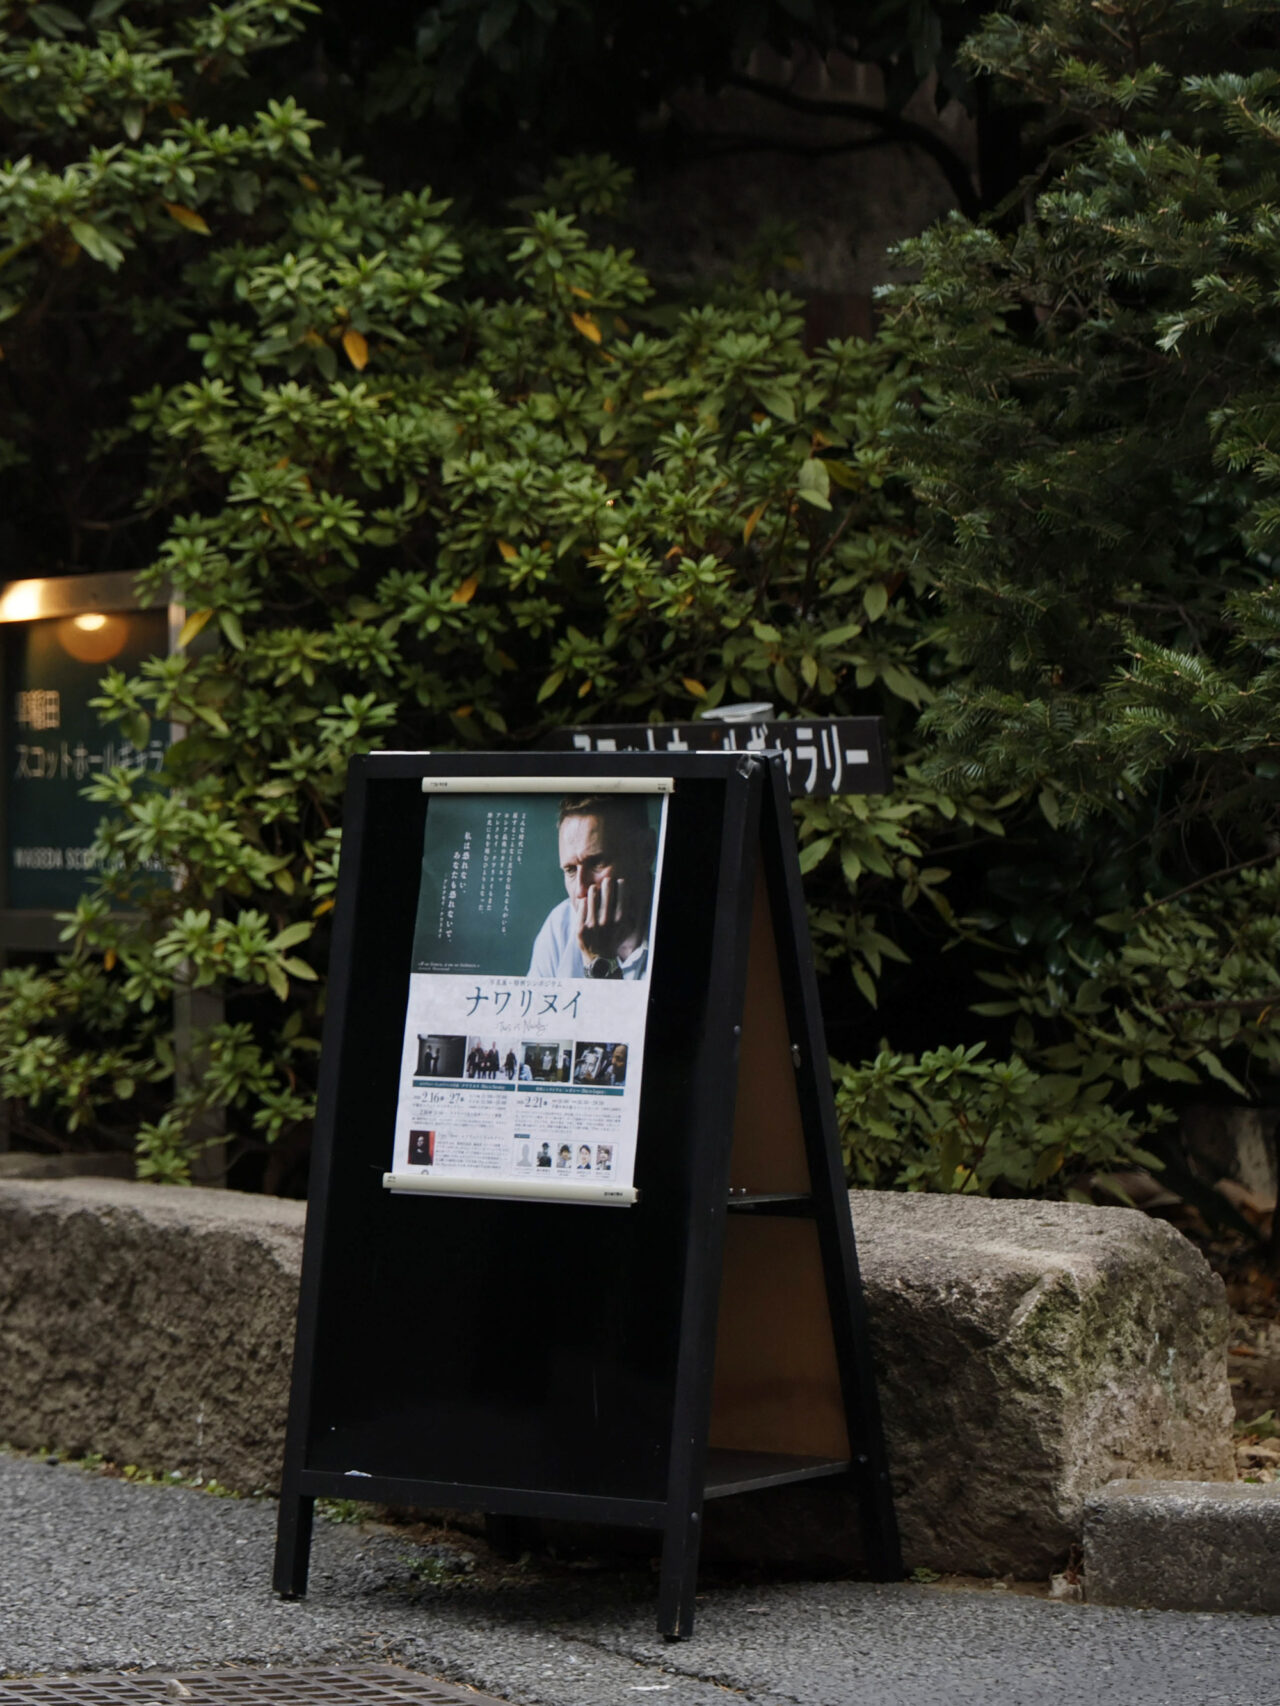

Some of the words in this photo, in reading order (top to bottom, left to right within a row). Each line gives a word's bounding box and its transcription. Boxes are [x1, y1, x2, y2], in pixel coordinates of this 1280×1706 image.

[465, 986, 581, 1019] ナワリヌイ
